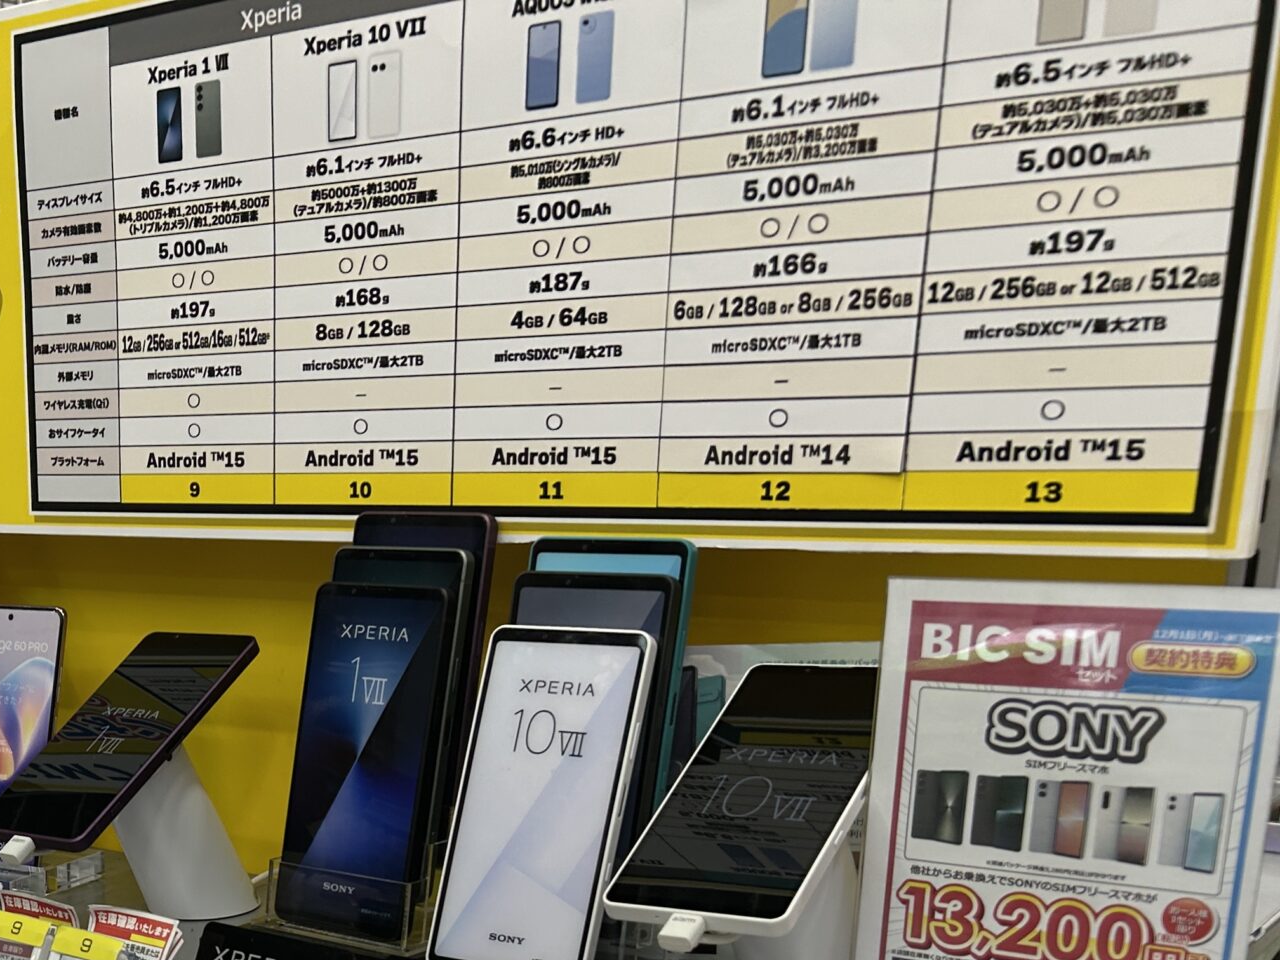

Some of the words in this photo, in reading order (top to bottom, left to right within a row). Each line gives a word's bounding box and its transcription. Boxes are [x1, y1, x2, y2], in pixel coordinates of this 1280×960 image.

[240, 1, 303, 31] Xperia
[304, 32, 363, 56] Xperia
[368, 23, 390, 45] 10
[148, 61, 198, 85] Xperia
[202, 57, 211, 75] 1
[731, 95, 821, 123] 約6.1インチ
[827, 91, 880, 110] フルHD+
[509, 128, 591, 152] 約6.6インチ
[595, 125, 625, 141] HD+
[306, 155, 374, 178] 約6.1インチ
[377, 152, 423, 168] フルHD+
[1017, 142, 1151, 173] 5,000mAh
[141, 178, 200, 200] 約6.5インチ
[204, 176, 242, 190] フルHD+
[743, 173, 855, 202] 5,000mAh
[516, 200, 612, 225] 5,000mAh
[323, 221, 405, 244] 5,000mAh
[158, 239, 228, 260] 5,000mAh
[927, 282, 975, 306] 12GB
[991, 276, 1057, 300] 256GB
[1060, 283, 1076, 295] or
[1080, 271, 1132, 294] 12GB
[1150, 265, 1220, 290] 512GB
[673, 300, 704, 320] 6GB
[719, 296, 777, 318] 128GB
[780, 303, 794, 315] or
[797, 292, 832, 313] 8GB
[848, 287, 913, 311] 256GB
[510, 310, 544, 330] 4GB
[558, 307, 608, 327] 64GB
[315, 323, 344, 341] 8GB
[357, 319, 411, 338] 128GB
[48, 427, 106, 439] おサイフケータイ
[147, 452, 207, 469] Android
[491, 446, 569, 466] Android
[189, 481, 200, 498] 9
[349, 481, 372, 499] 10
[538, 481, 564, 499] 11
[760, 480, 791, 501] 12
[1023, 481, 1064, 503] 13
[341, 623, 409, 643] XPERIA
[14, 641, 26, 651] 60
[27, 642, 48, 653] PRO
[920, 622, 1009, 664] BIC
[1022, 625, 1121, 668] SIM
[1144, 648, 1238, 671] 契約特典
[1076, 669, 1118, 684] セット
[519, 678, 596, 698] XPERIA
[102, 704, 161, 722] XPERIA
[989, 702, 1159, 760] SONY
[726, 746, 839, 767] XPERIA
[1025, 759, 1110, 776] SIMフリースマホ
[323, 881, 356, 895] SONY
[10, 920, 23, 935] 9
[96, 911, 171, 937] 在庫確認いたします
[80, 938, 93, 953] 9
[488, 932, 526, 945] SONY
